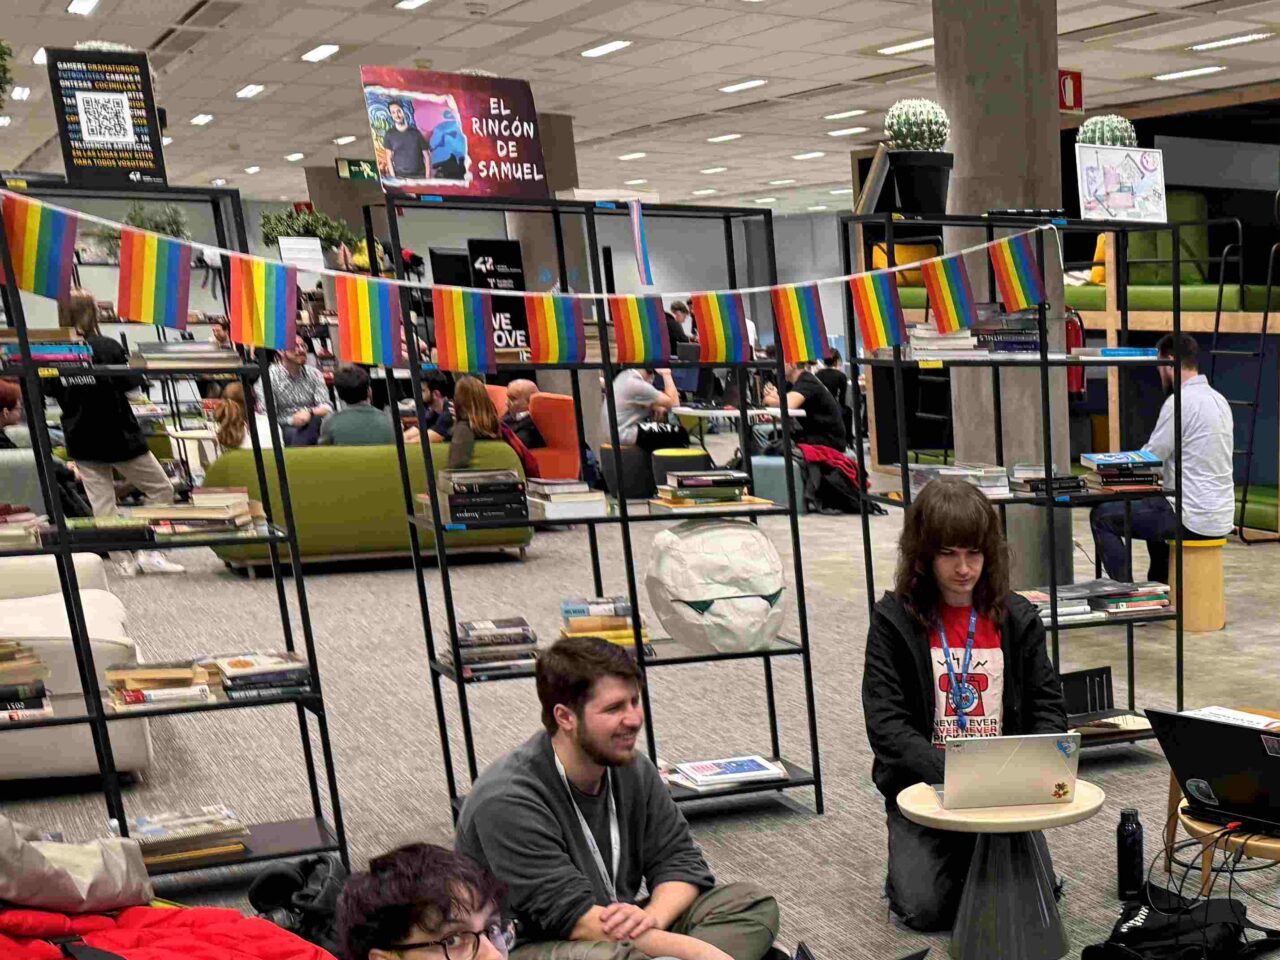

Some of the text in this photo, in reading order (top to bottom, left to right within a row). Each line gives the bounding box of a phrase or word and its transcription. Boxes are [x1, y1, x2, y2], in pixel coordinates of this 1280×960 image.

[489, 97, 511, 116] EL
[471, 116, 534, 139] RINCÓN
[497, 140, 518, 158] DE
[478, 160, 544, 181] SAMUEL
[492, 329, 528, 348] OVE
[964, 726, 997, 734] NEVER
[970, 719, 997, 727] EVER
